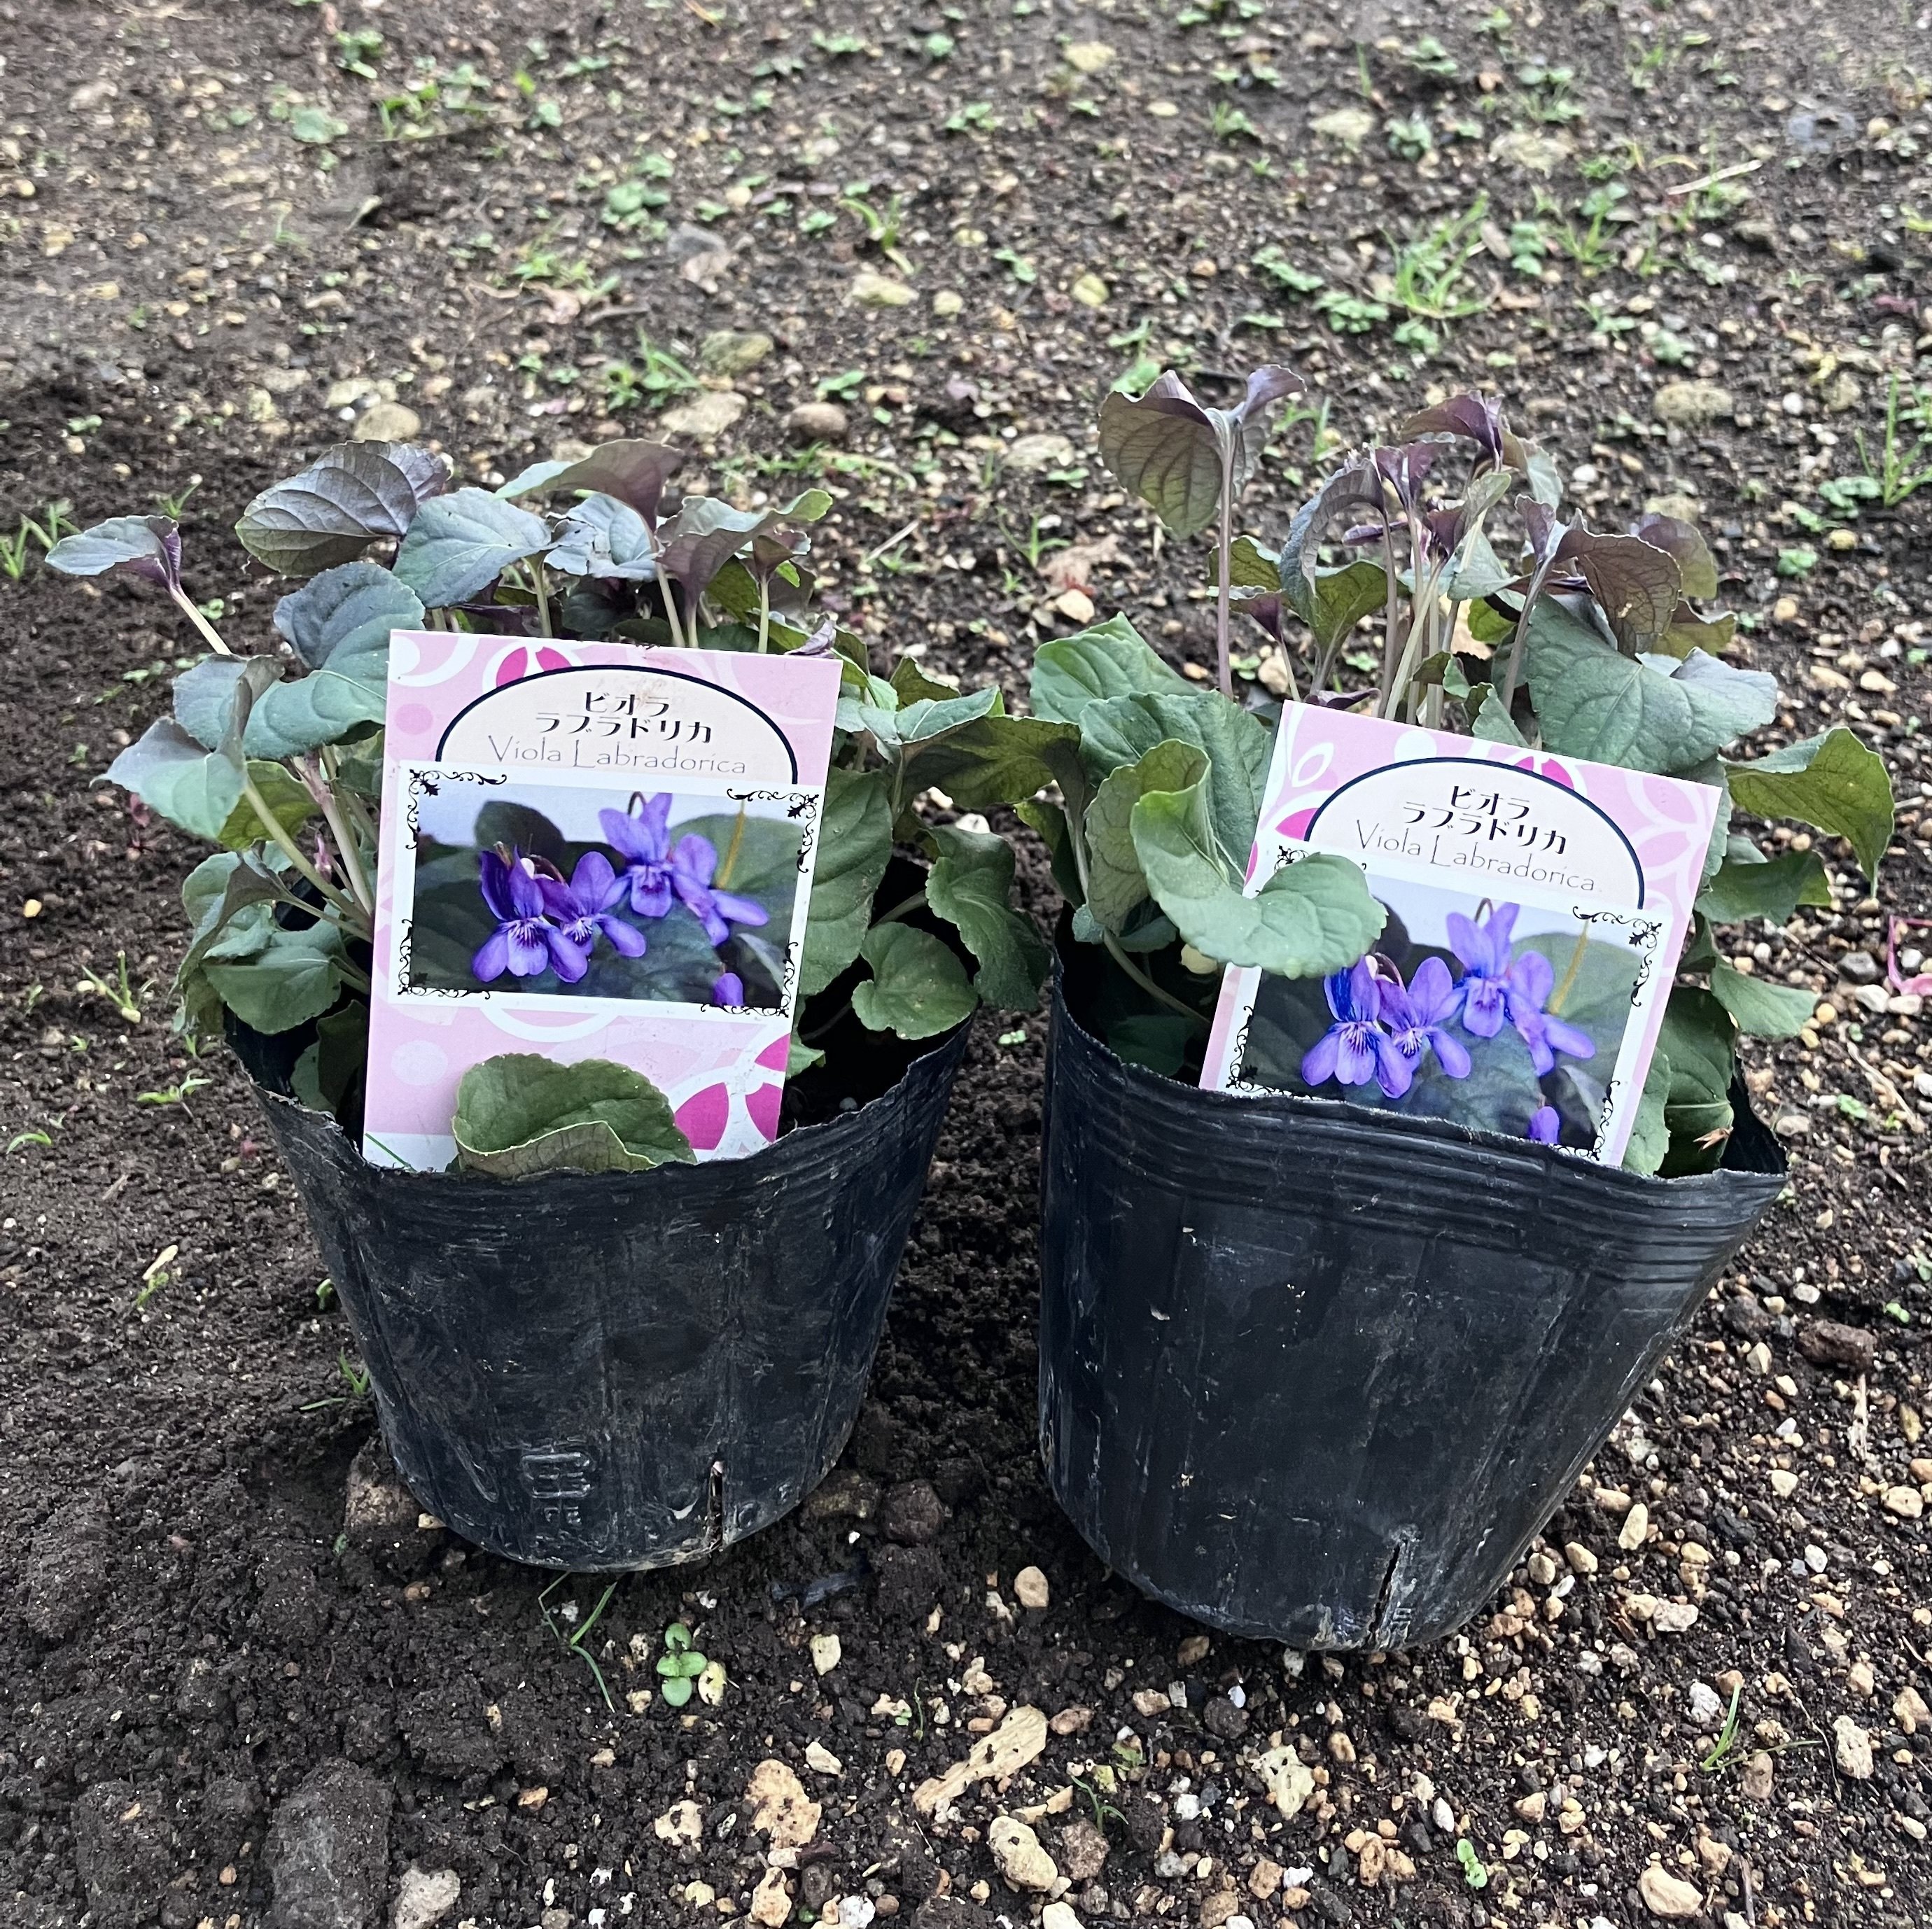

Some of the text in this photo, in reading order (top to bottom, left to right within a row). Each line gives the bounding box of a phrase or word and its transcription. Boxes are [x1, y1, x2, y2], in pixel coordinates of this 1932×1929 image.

[584, 691, 670, 717] ビオラ
[536, 713, 711, 743] ラブラドリカ
[488, 734, 746, 773] Viola Labradorica
[1450, 785, 1530, 820] ビオラ
[1403, 801, 1567, 855] ラブラドリカ
[1356, 819, 1595, 892] Viola Labradorica
